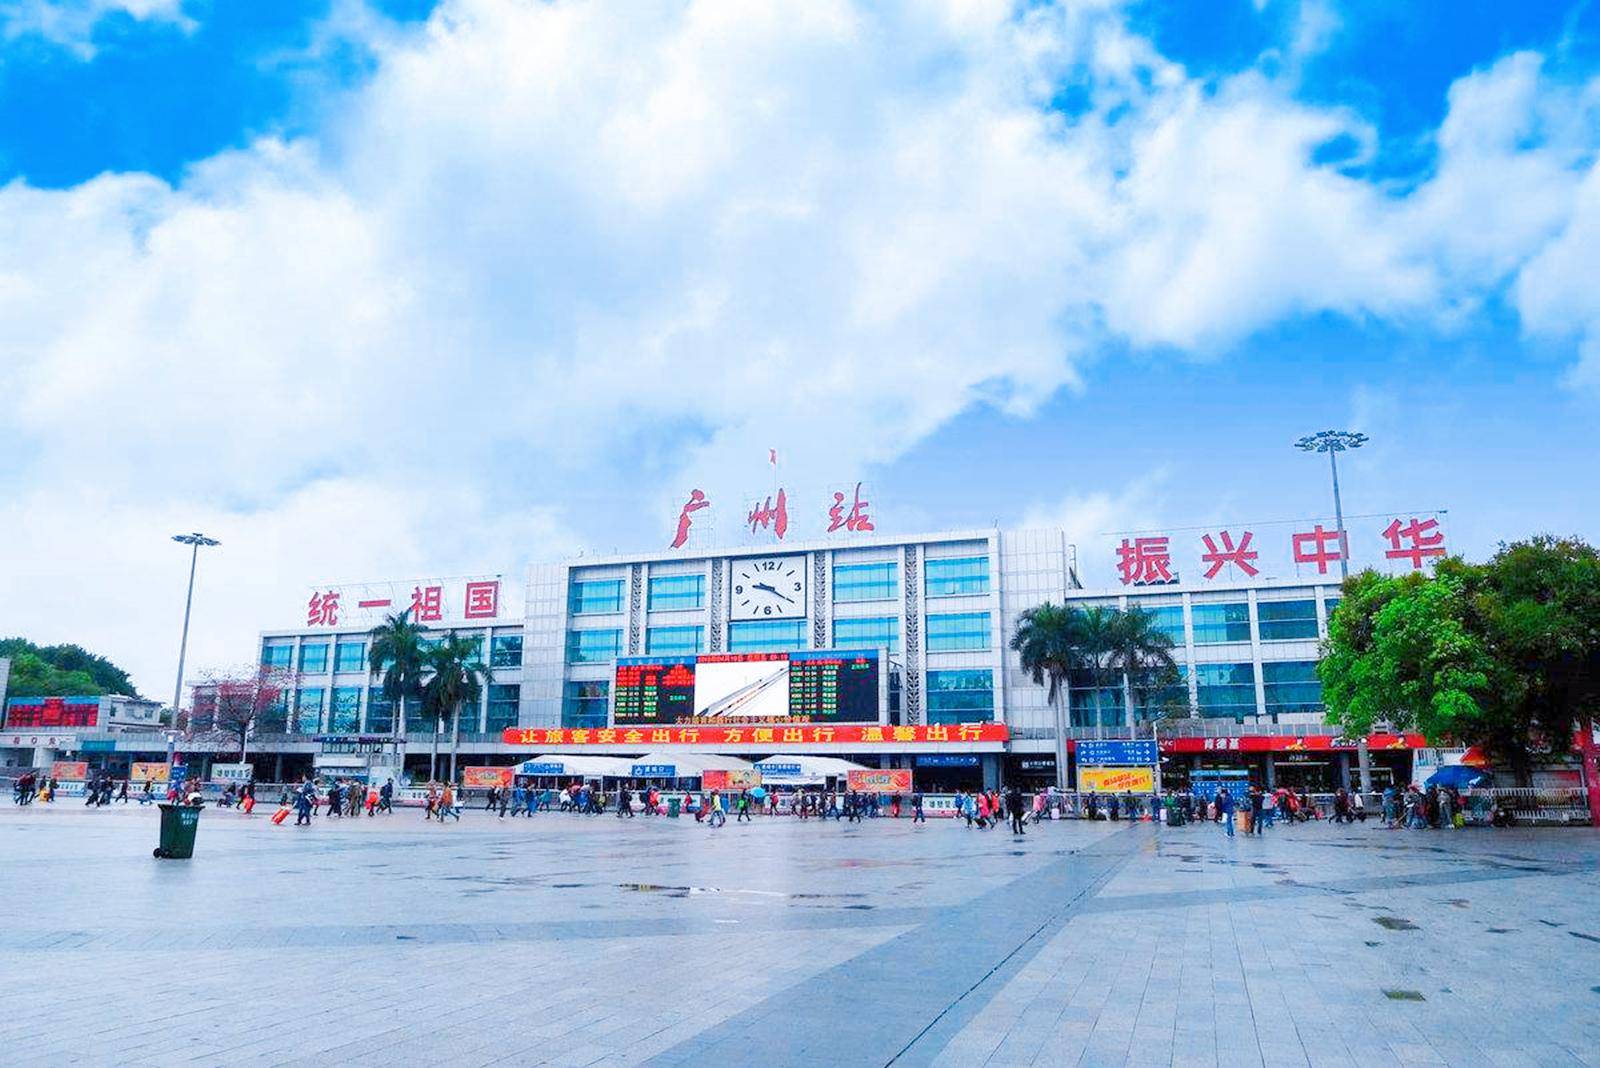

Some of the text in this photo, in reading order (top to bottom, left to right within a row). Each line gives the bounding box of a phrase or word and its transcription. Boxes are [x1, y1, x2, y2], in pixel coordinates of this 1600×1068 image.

[669, 482, 874, 550] 广州站
[1115, 518, 1446, 585] 振兴中华
[762, 561, 775, 571] 12
[735, 585, 743, 595] 9
[794, 582, 801, 591] 3
[307, 581, 499, 626] 统一祖国
[763, 606, 772, 615] 6
[520, 725, 984, 744] 让旅客安全出行 方便出行 温馨出行
[1204, 738, 1240, 750] 肯德基
